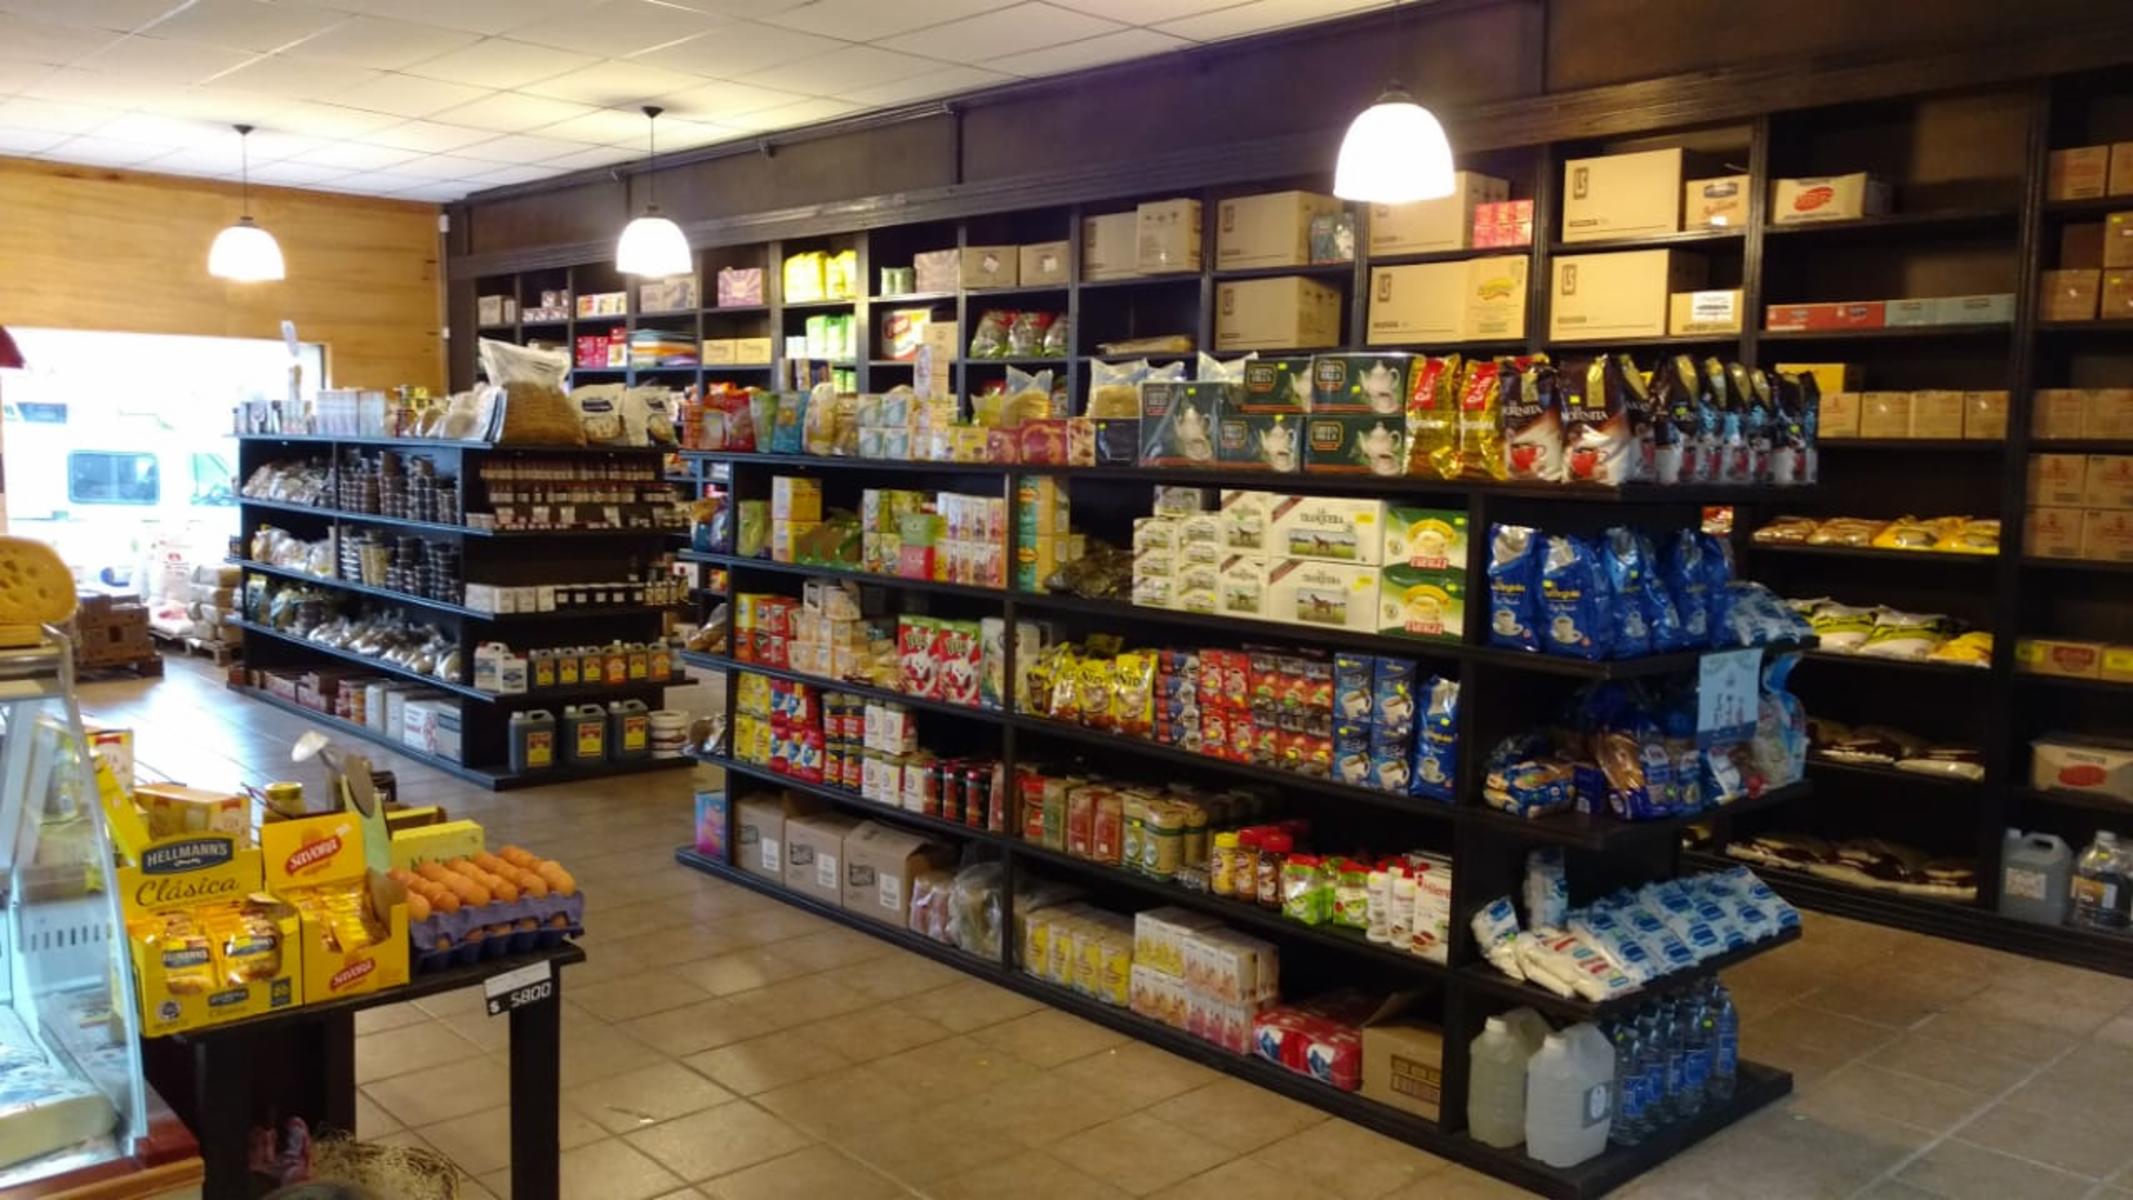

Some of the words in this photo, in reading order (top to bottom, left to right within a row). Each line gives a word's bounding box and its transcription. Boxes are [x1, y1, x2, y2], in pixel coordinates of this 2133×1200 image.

[146, 842, 229, 868] HELLMANN'S
[134, 877, 240, 907] Clásica
[489, 1000, 500, 1013] $
[510, 983, 552, 1008] 5800
